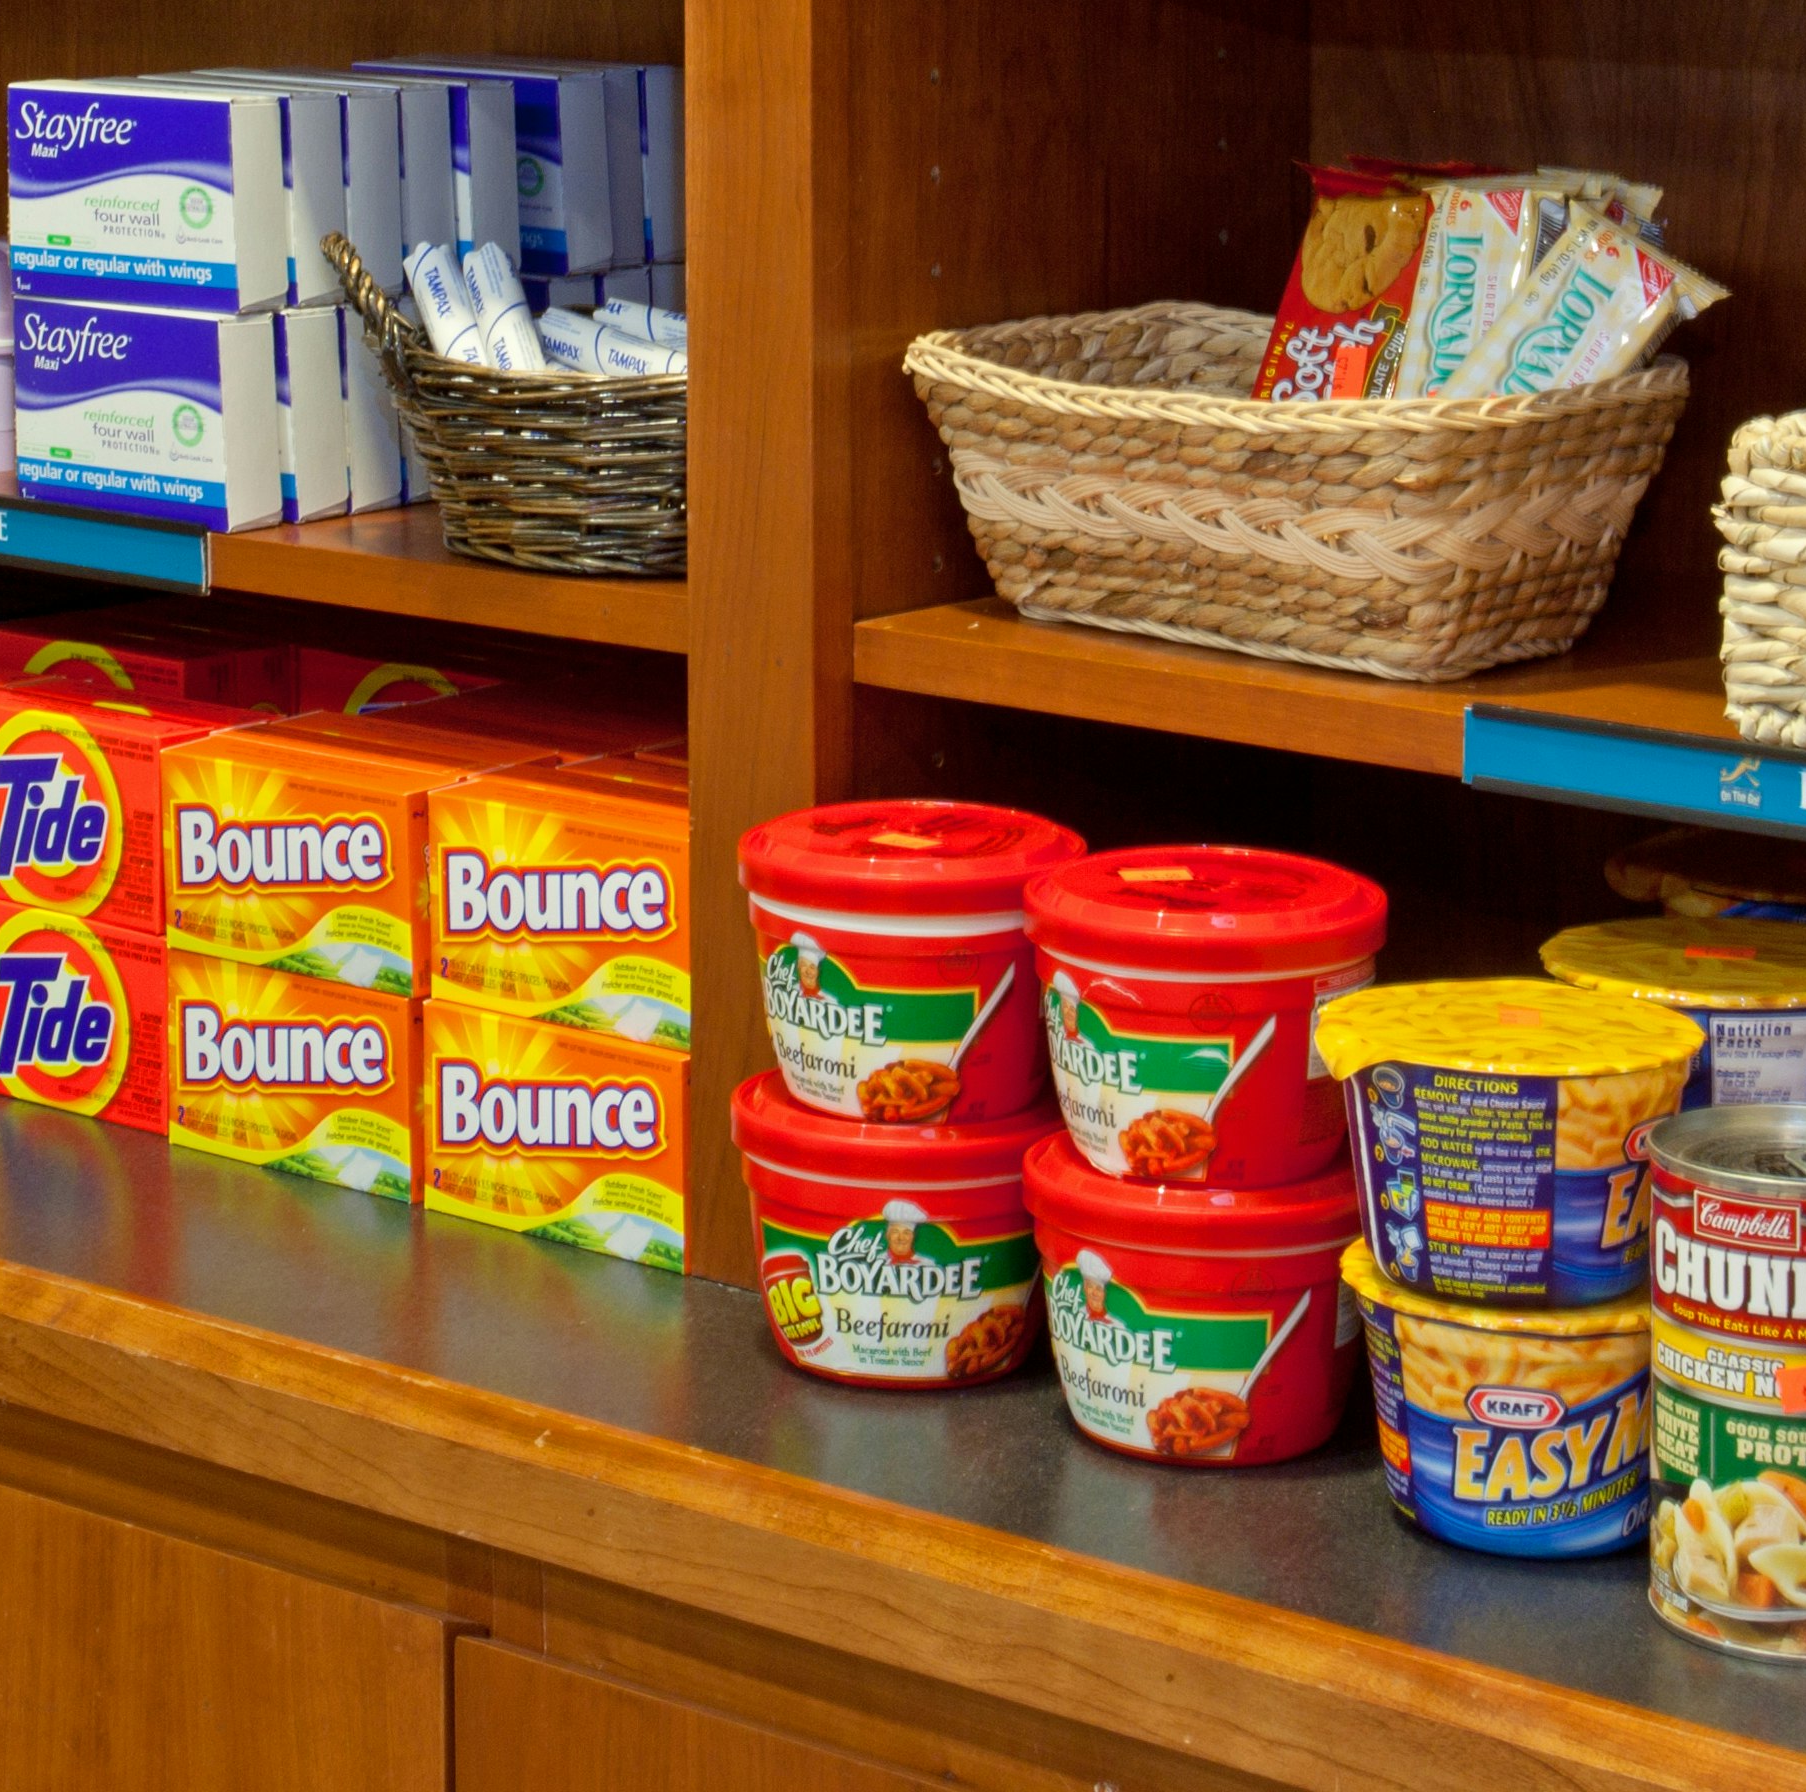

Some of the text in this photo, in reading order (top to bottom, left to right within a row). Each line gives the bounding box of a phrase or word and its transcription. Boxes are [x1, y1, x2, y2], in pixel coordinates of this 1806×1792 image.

[15, 100, 132, 156] Stayfree
[31, 141, 59, 160] Maxi
[83, 193, 161, 213] reinforced
[93, 207, 161, 228] four wall
[102, 224, 164, 240] PROTECTION
[13, 248, 213, 285] regular or regular with wings
[424, 266, 452, 320] TAMPAX
[19, 312, 129, 366] Stayfree
[606, 346, 649, 376] TAMPAX
[180, 808, 384, 885] Bounce
[445, 851, 667, 934] Bounce
[767, 953, 796, 984] Chef
[762, 978, 887, 1046] BOYARDEE
[183, 1006, 387, 1084] Bounce
[775, 1032, 858, 1080] Beefaroni
[1414, 1087, 1459, 1104] REMOVE
[1433, 1074, 1520, 1096] DIRECTIONS
[439, 1063, 659, 1150] Bounce
[1698, 1197, 1793, 1242] Campbell's
[827, 1226, 885, 1260] Chef
[816, 1254, 984, 1304] BOYARDEE
[768, 1277, 822, 1327] BIG
[835, 1305, 951, 1340] Beefaroni
[1048, 1306, 1178, 1373] BOYARDEE
[1706, 1347, 1785, 1376] CLASSIC
[1486, 1399, 1545, 1418] KRAFT
[1725, 1419, 1772, 1443] GOOD
[1454, 1414, 1610, 1503] EASY
